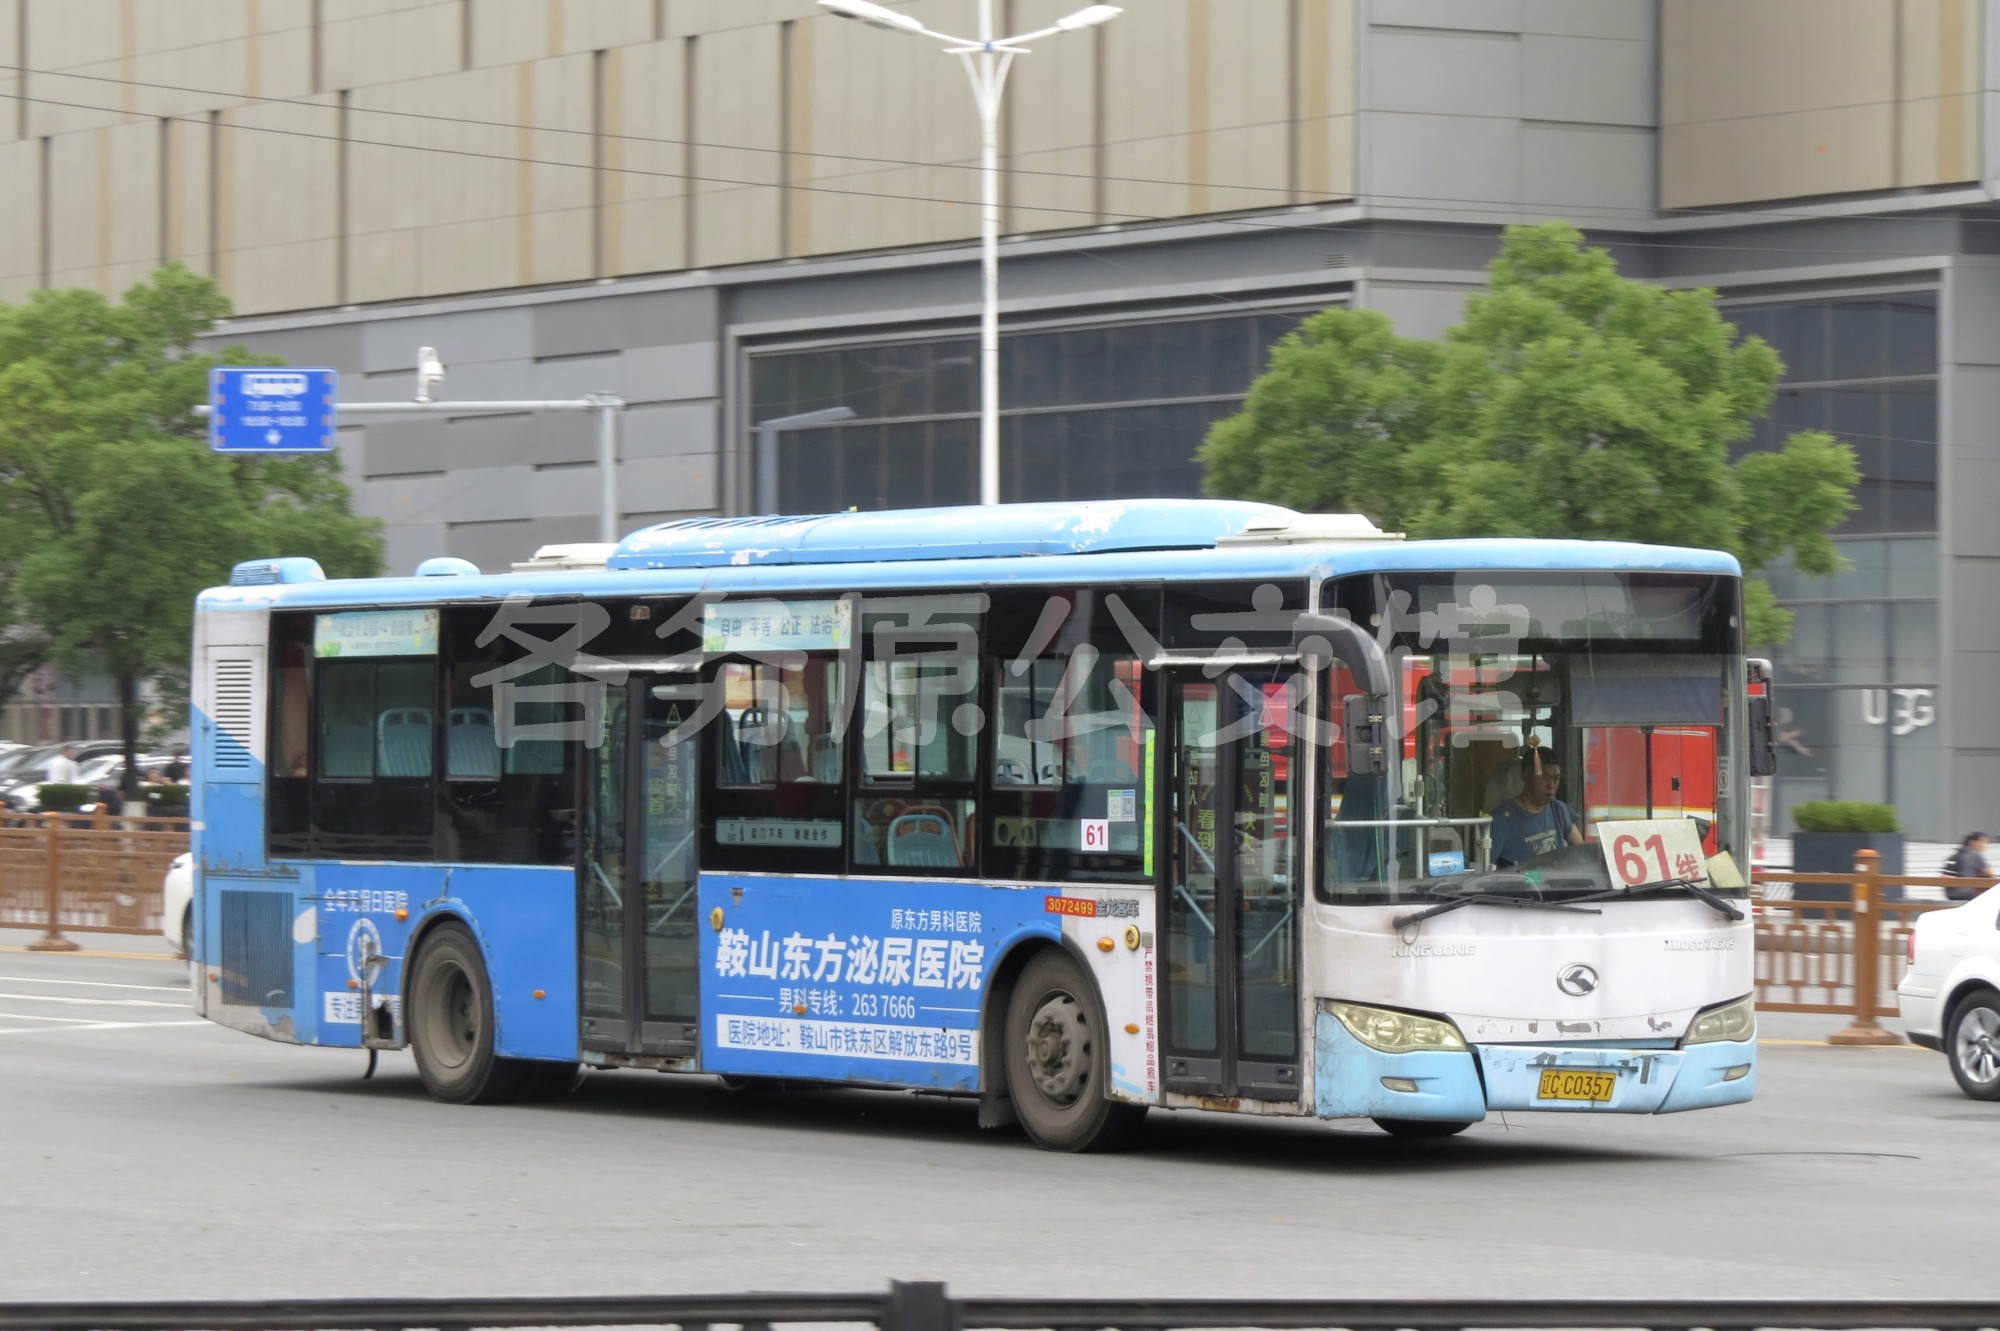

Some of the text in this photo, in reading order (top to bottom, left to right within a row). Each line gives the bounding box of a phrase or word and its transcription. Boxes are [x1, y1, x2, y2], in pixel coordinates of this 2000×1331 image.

[721, 614, 833, 637] 自由 平等 公正 法治
[1086, 824, 1104, 846] 61
[1612, 833, 1700, 885] 61线
[1048, 898, 1094, 915] 3072499
[1095, 898, 1139, 918] 金龙客车
[891, 908, 982, 933] 原东方男科医院
[715, 928, 984, 990] 鞍山东方泌尿医院
